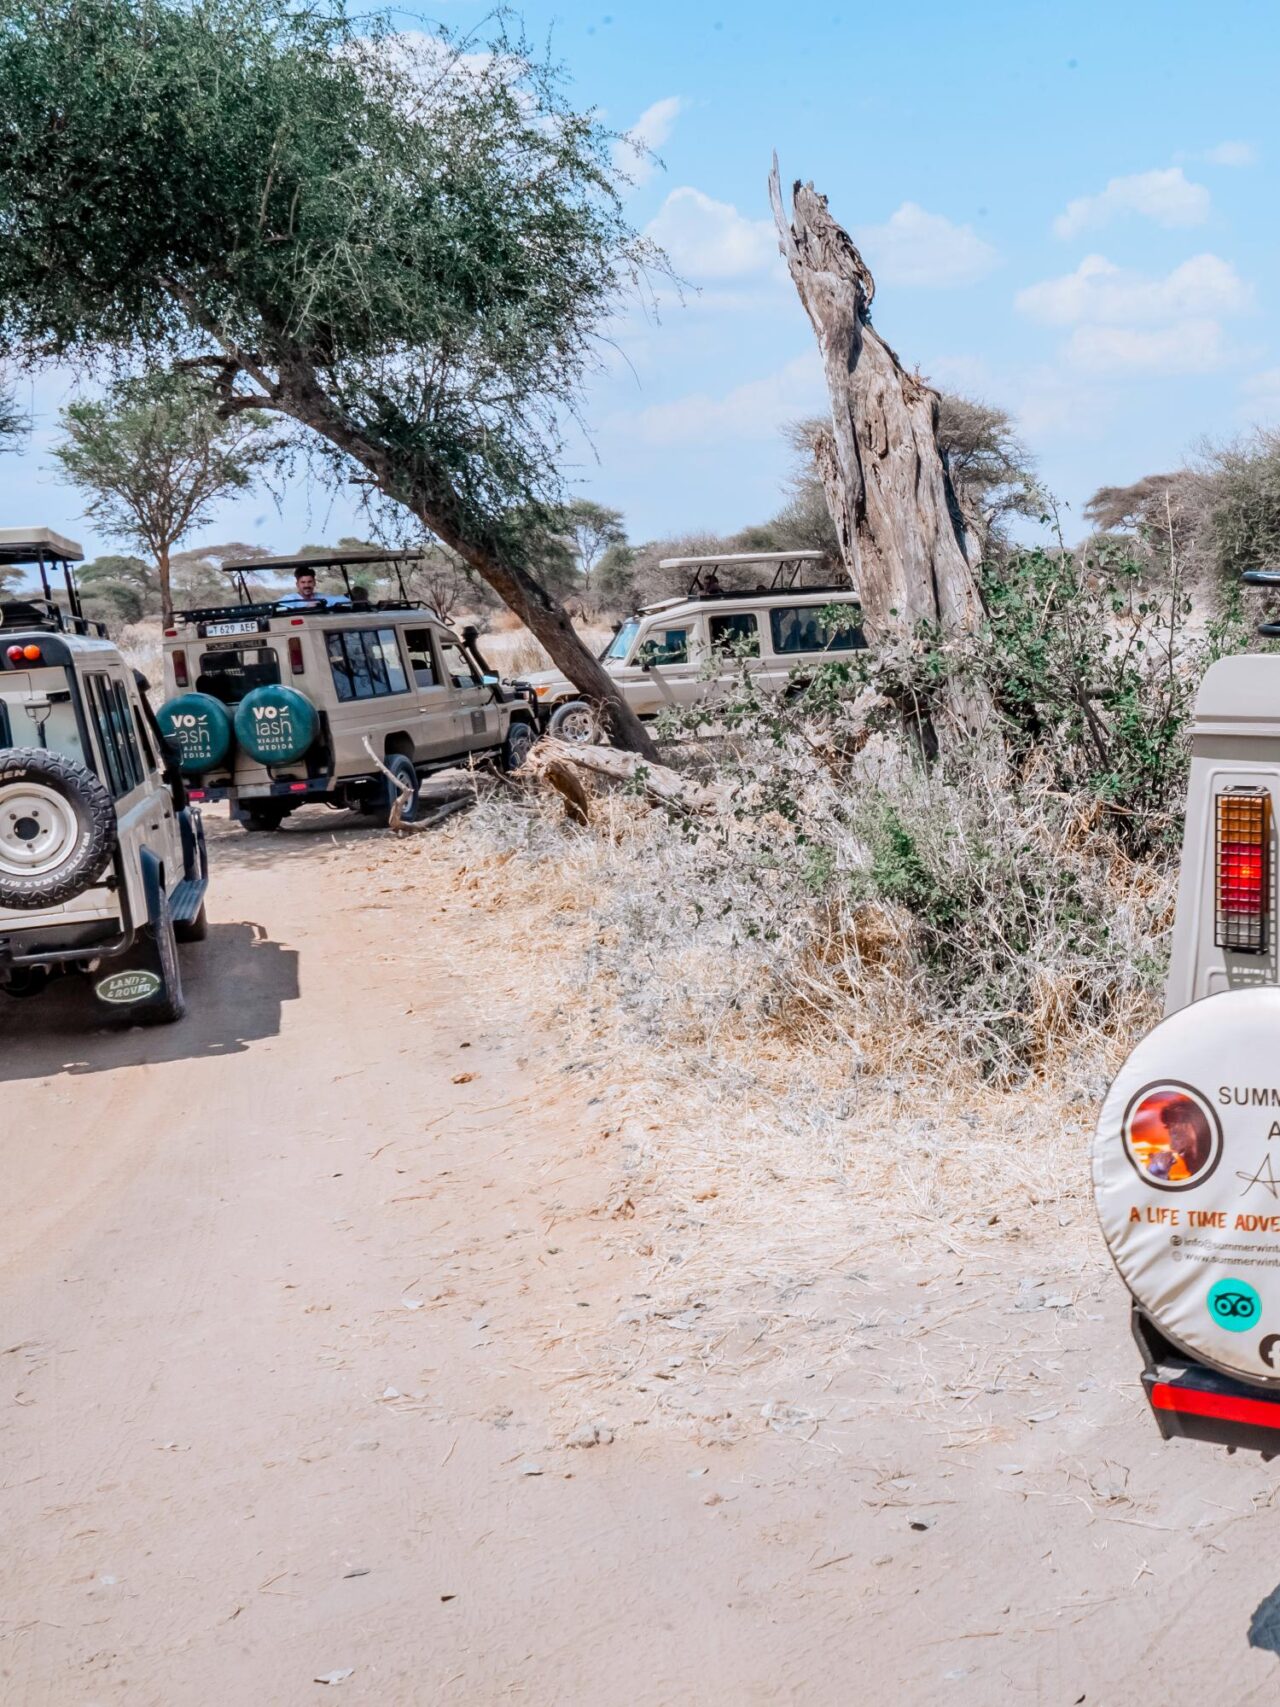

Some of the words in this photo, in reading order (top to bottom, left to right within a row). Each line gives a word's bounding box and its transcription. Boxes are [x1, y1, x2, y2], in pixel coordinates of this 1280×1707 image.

[220, 624, 235, 634] 629
[240, 622, 256, 632] AEF
[255, 718, 292, 736] iash
[176, 727, 210, 744] ash
[258, 743, 293, 751] MEDIDA
[184, 751, 211, 759] EDIDA
[110, 976, 139, 990] LAND
[115, 983, 151, 998] ROVER
[1129, 1206, 1141, 1223] A
[1146, 1207, 1180, 1227] LIFE
[1187, 1210, 1228, 1229] TIME
